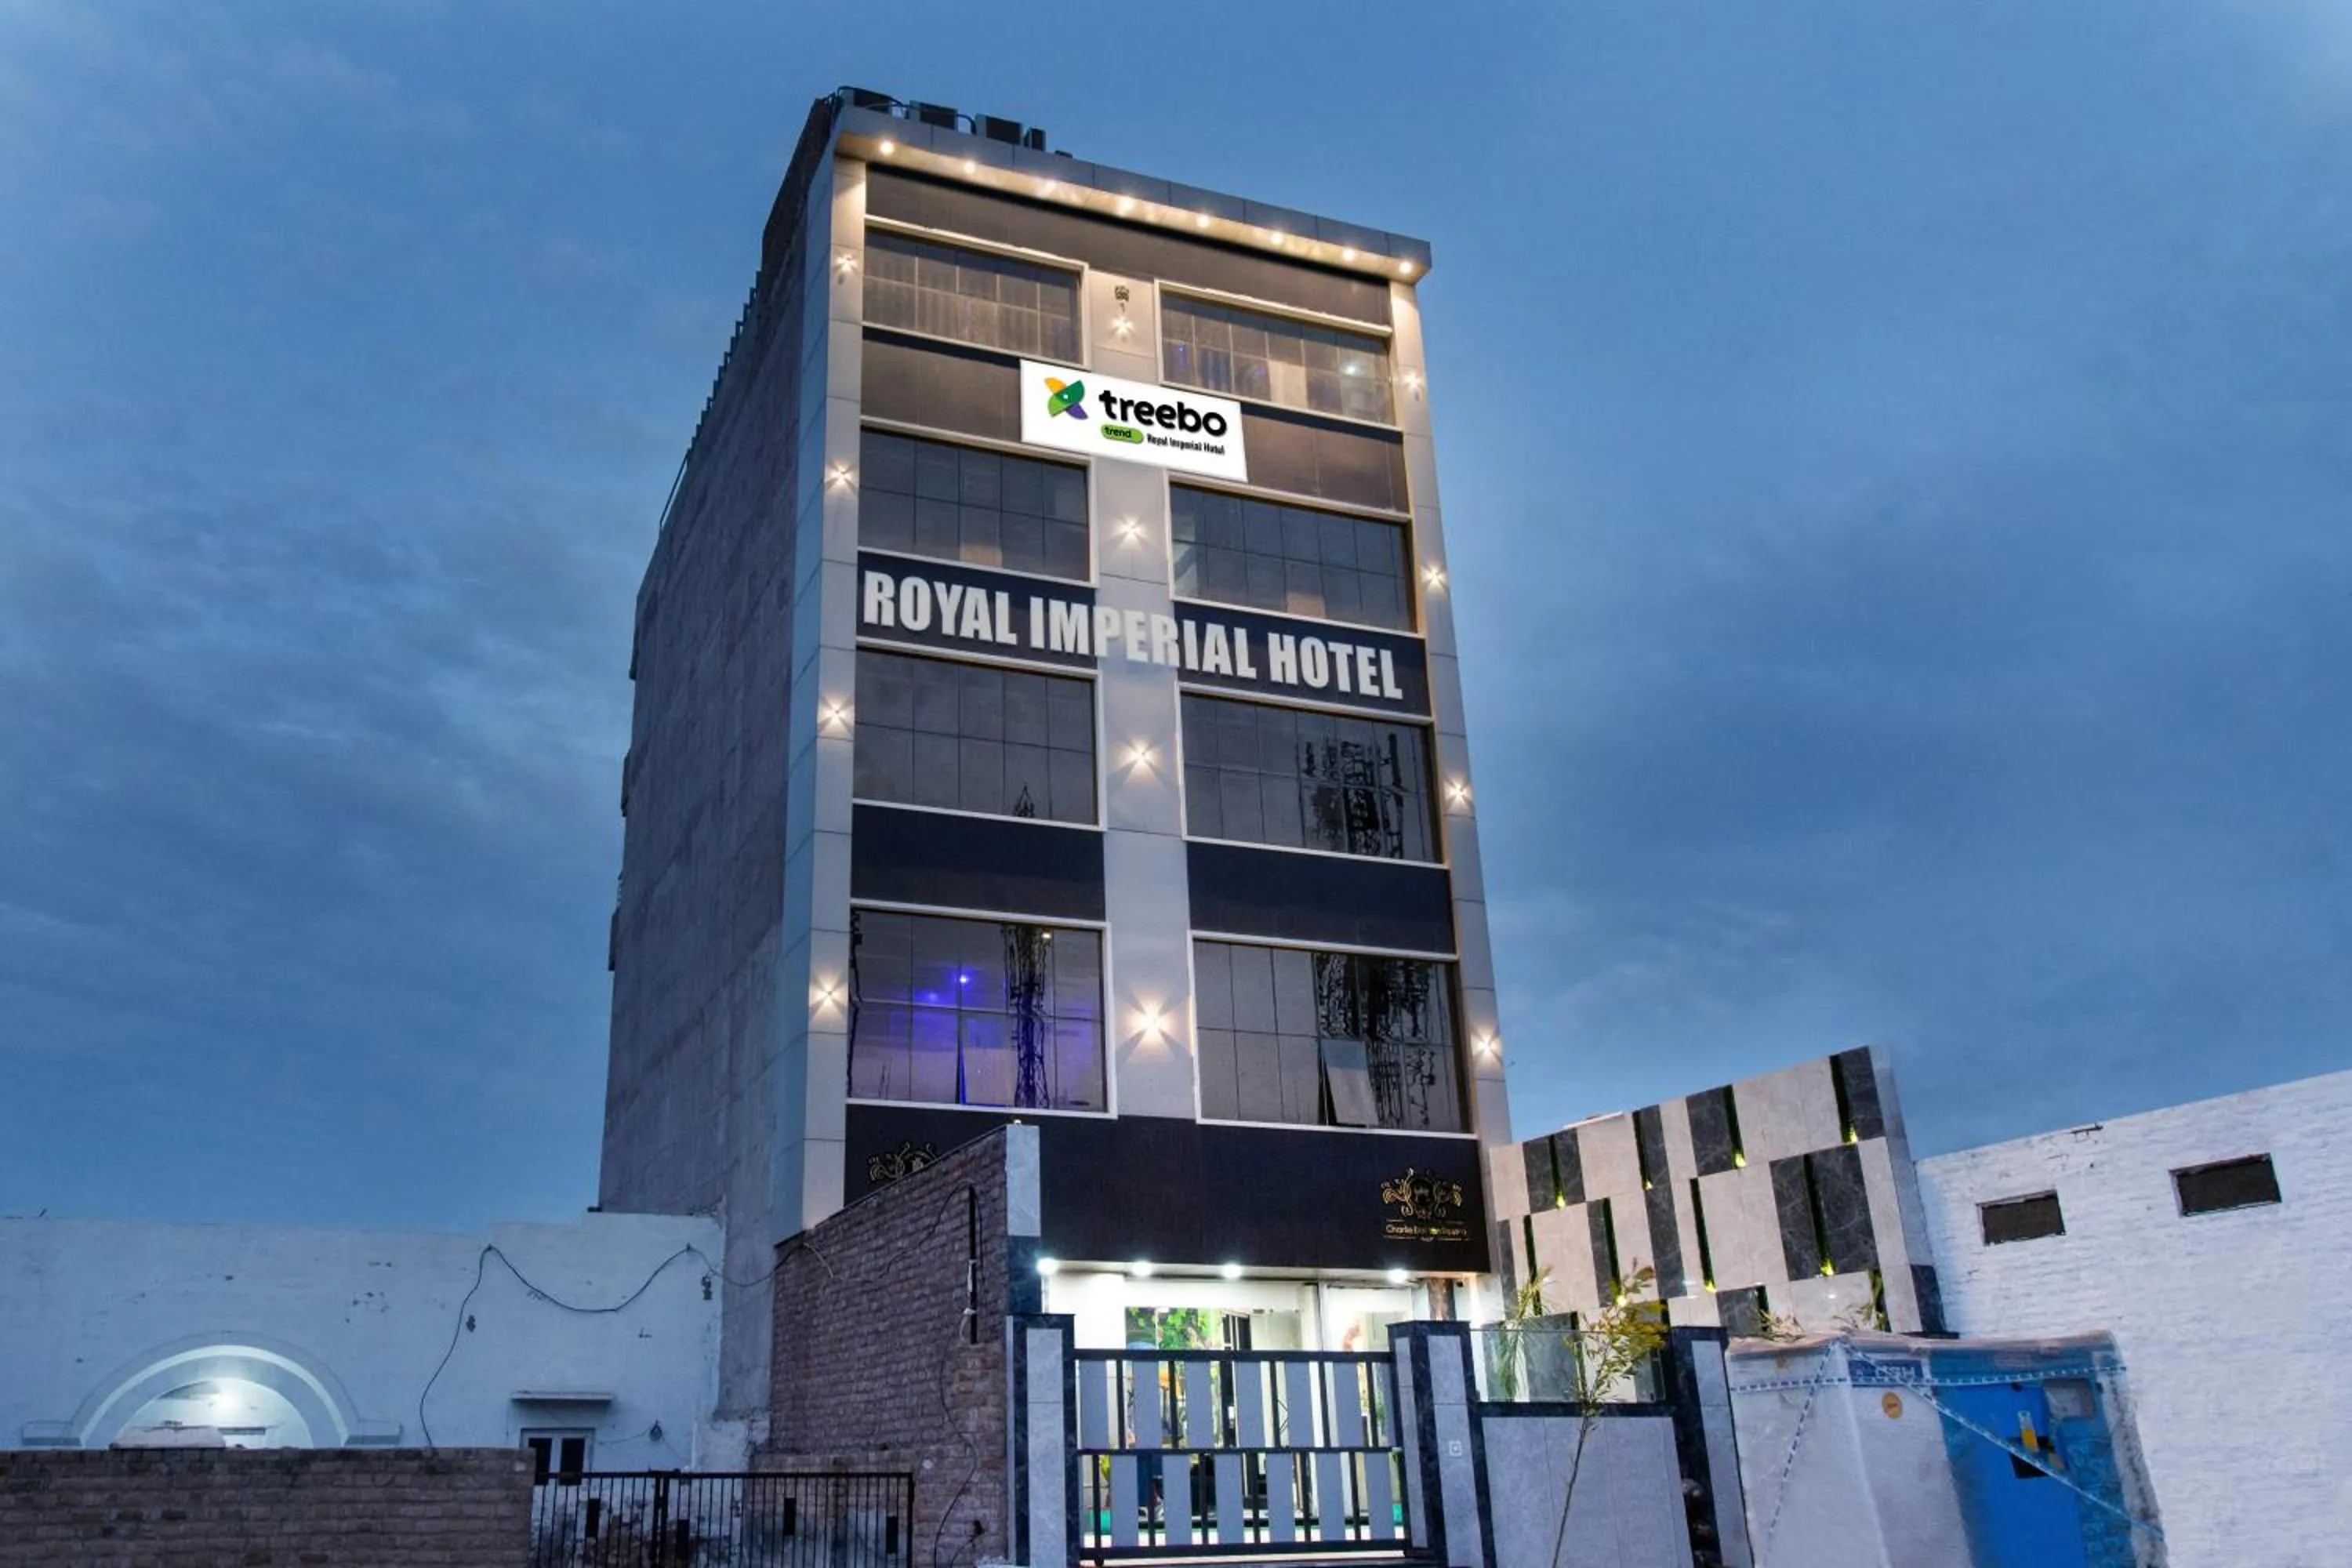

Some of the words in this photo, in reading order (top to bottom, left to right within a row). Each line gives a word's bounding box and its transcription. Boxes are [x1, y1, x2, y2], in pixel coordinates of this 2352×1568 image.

[1098, 390, 1227, 437] treebo
[1104, 426, 1132, 438] trend
[863, 570, 1018, 645] ROYAL
[1029, 596, 1257, 680] IMPERIAL
[1267, 632, 1403, 700] HOTEL
